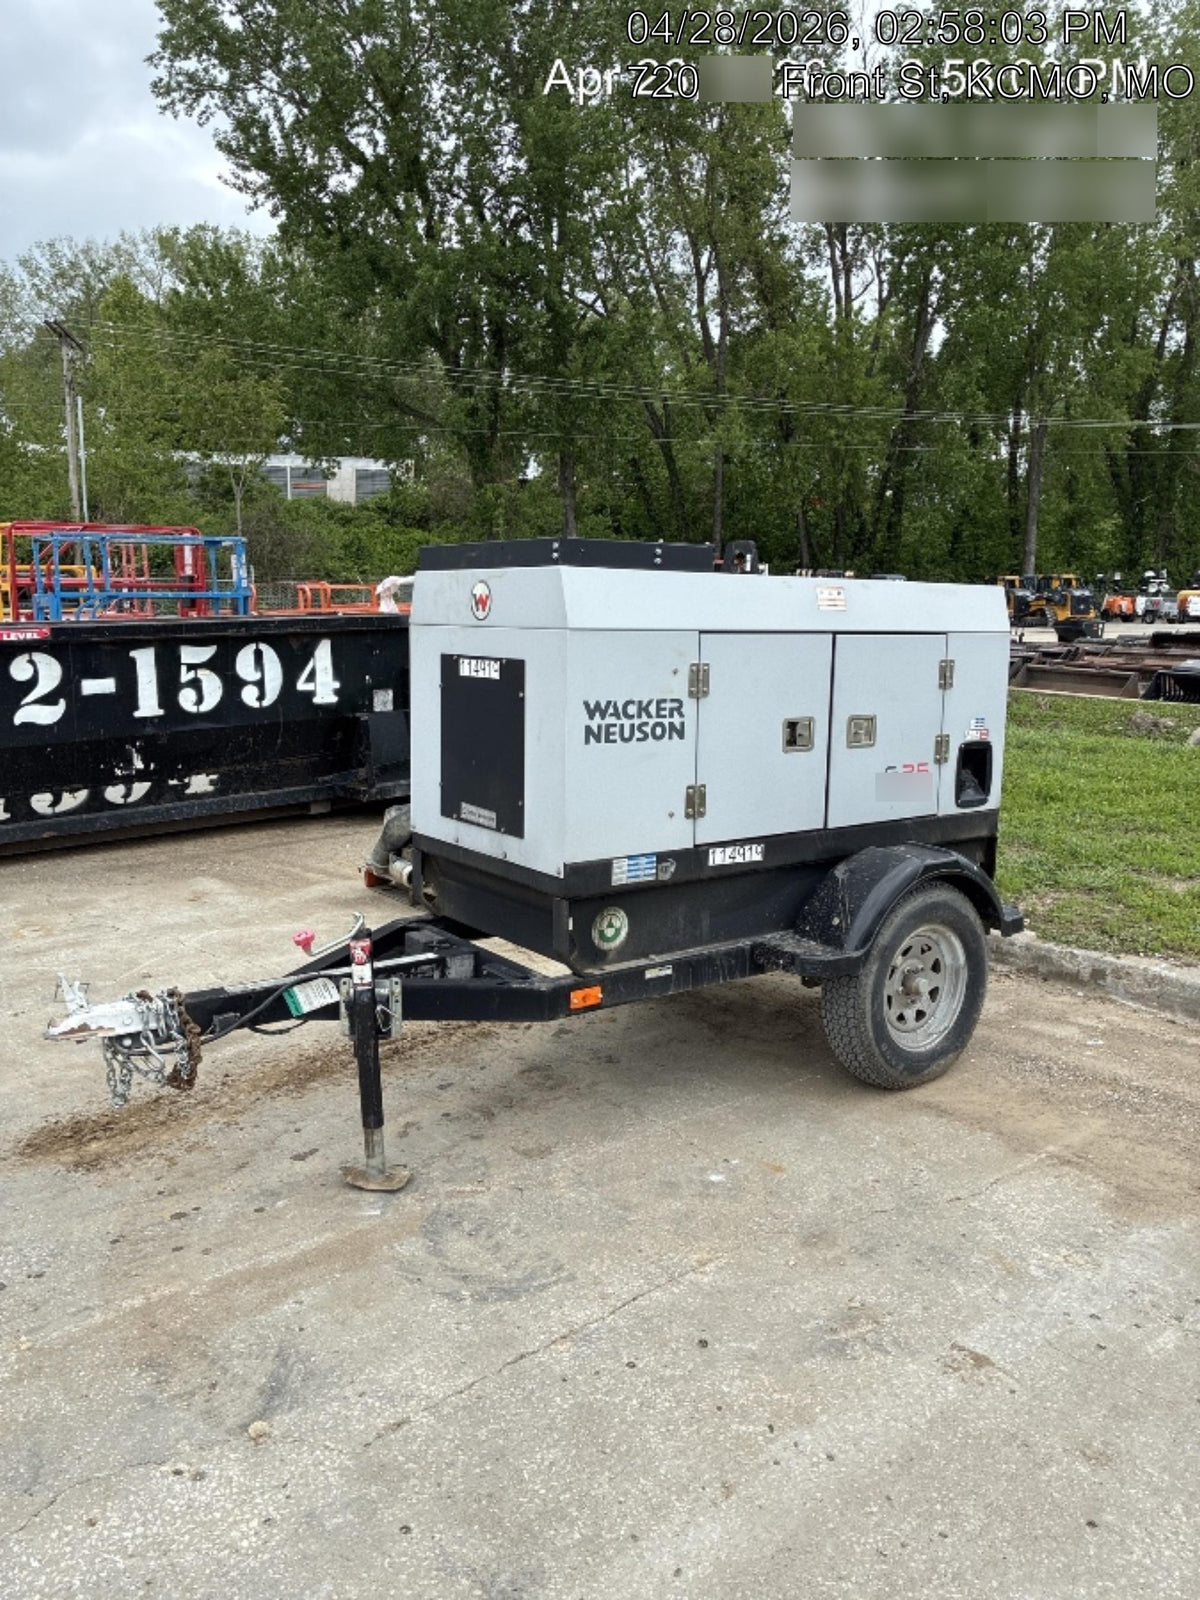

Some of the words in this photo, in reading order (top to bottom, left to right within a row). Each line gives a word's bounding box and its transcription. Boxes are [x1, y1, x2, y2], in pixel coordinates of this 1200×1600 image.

[8, 637, 341, 727] 2-1594
[582, 698, 686, 722] WACKER
[583, 720, 686, 746] NEUSON
